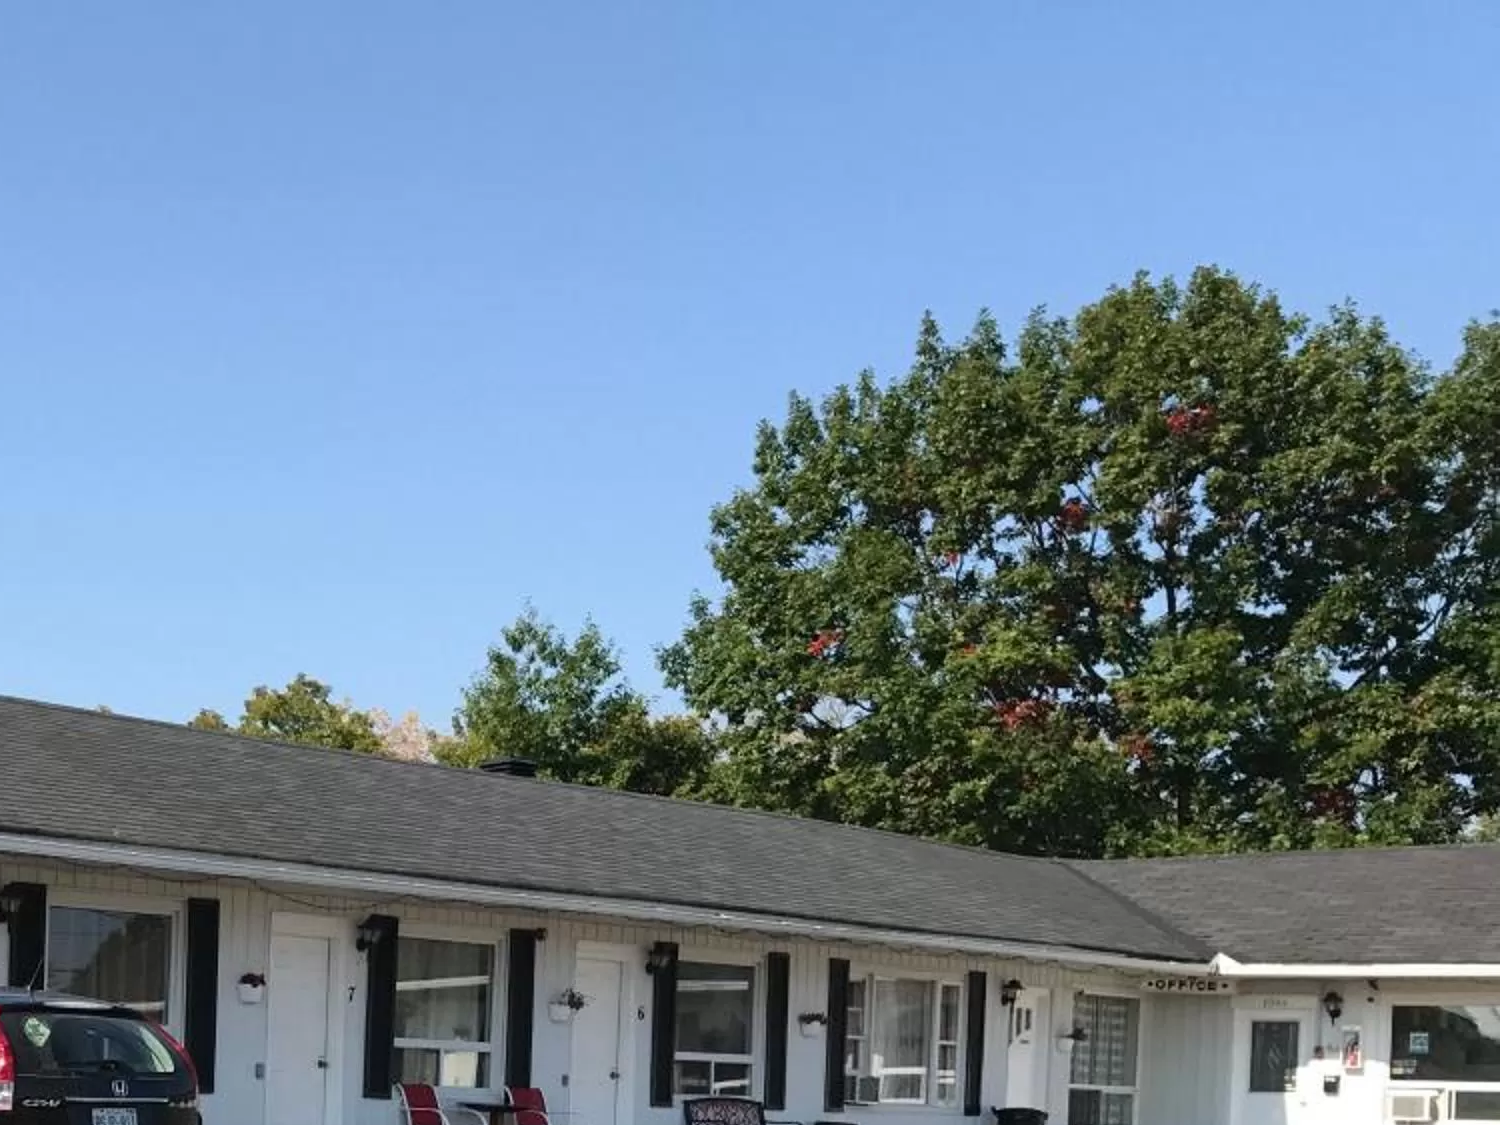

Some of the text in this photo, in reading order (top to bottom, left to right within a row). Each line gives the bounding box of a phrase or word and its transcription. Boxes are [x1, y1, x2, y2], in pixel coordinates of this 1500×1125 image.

[1155, 979, 1217, 992] OFFICE
[347, 985, 357, 1003] 7
[637, 1005, 645, 1021] 6
